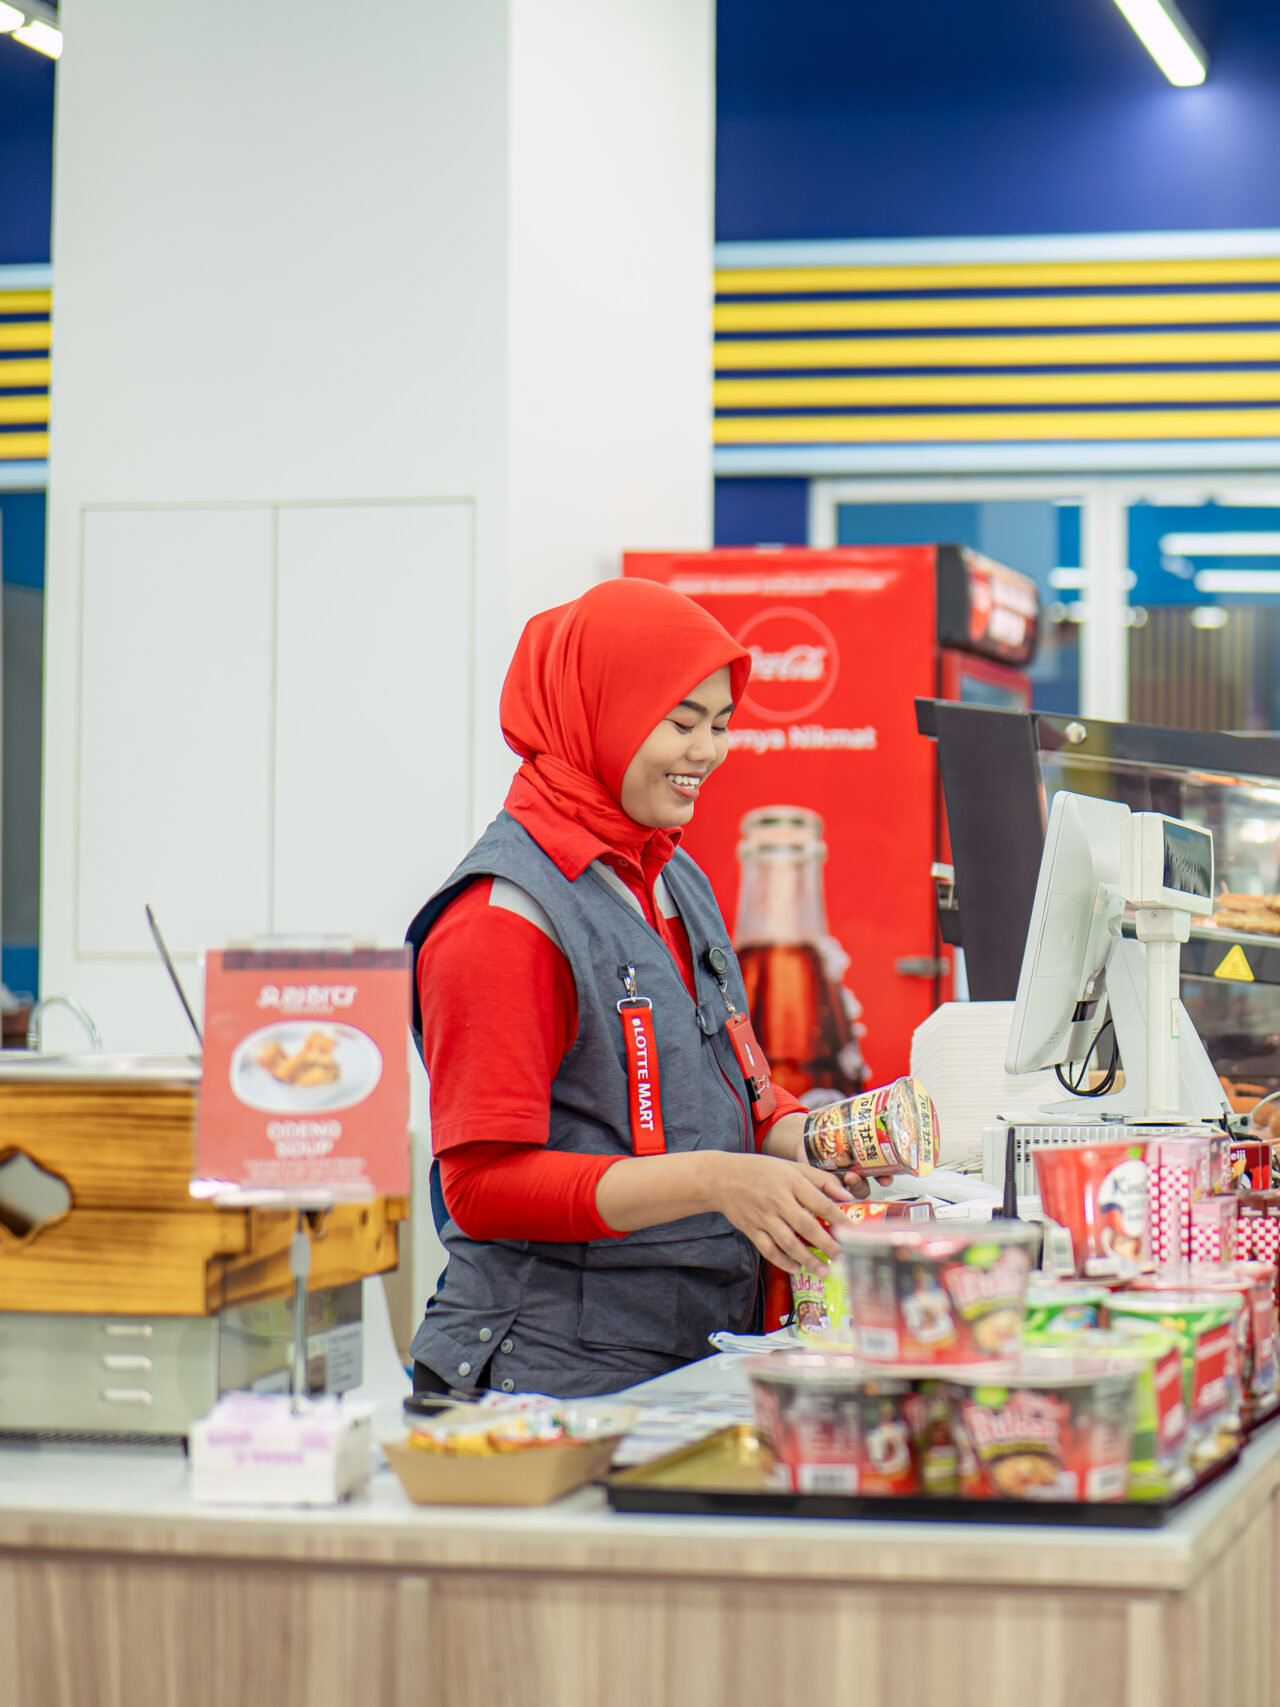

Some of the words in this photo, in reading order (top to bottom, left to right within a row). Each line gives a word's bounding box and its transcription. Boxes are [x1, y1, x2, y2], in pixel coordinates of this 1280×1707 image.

[633, 1027, 648, 1079] LOTTE
[638, 1083, 654, 1131] MART
[1231, 1149, 1246, 1161] eiji
